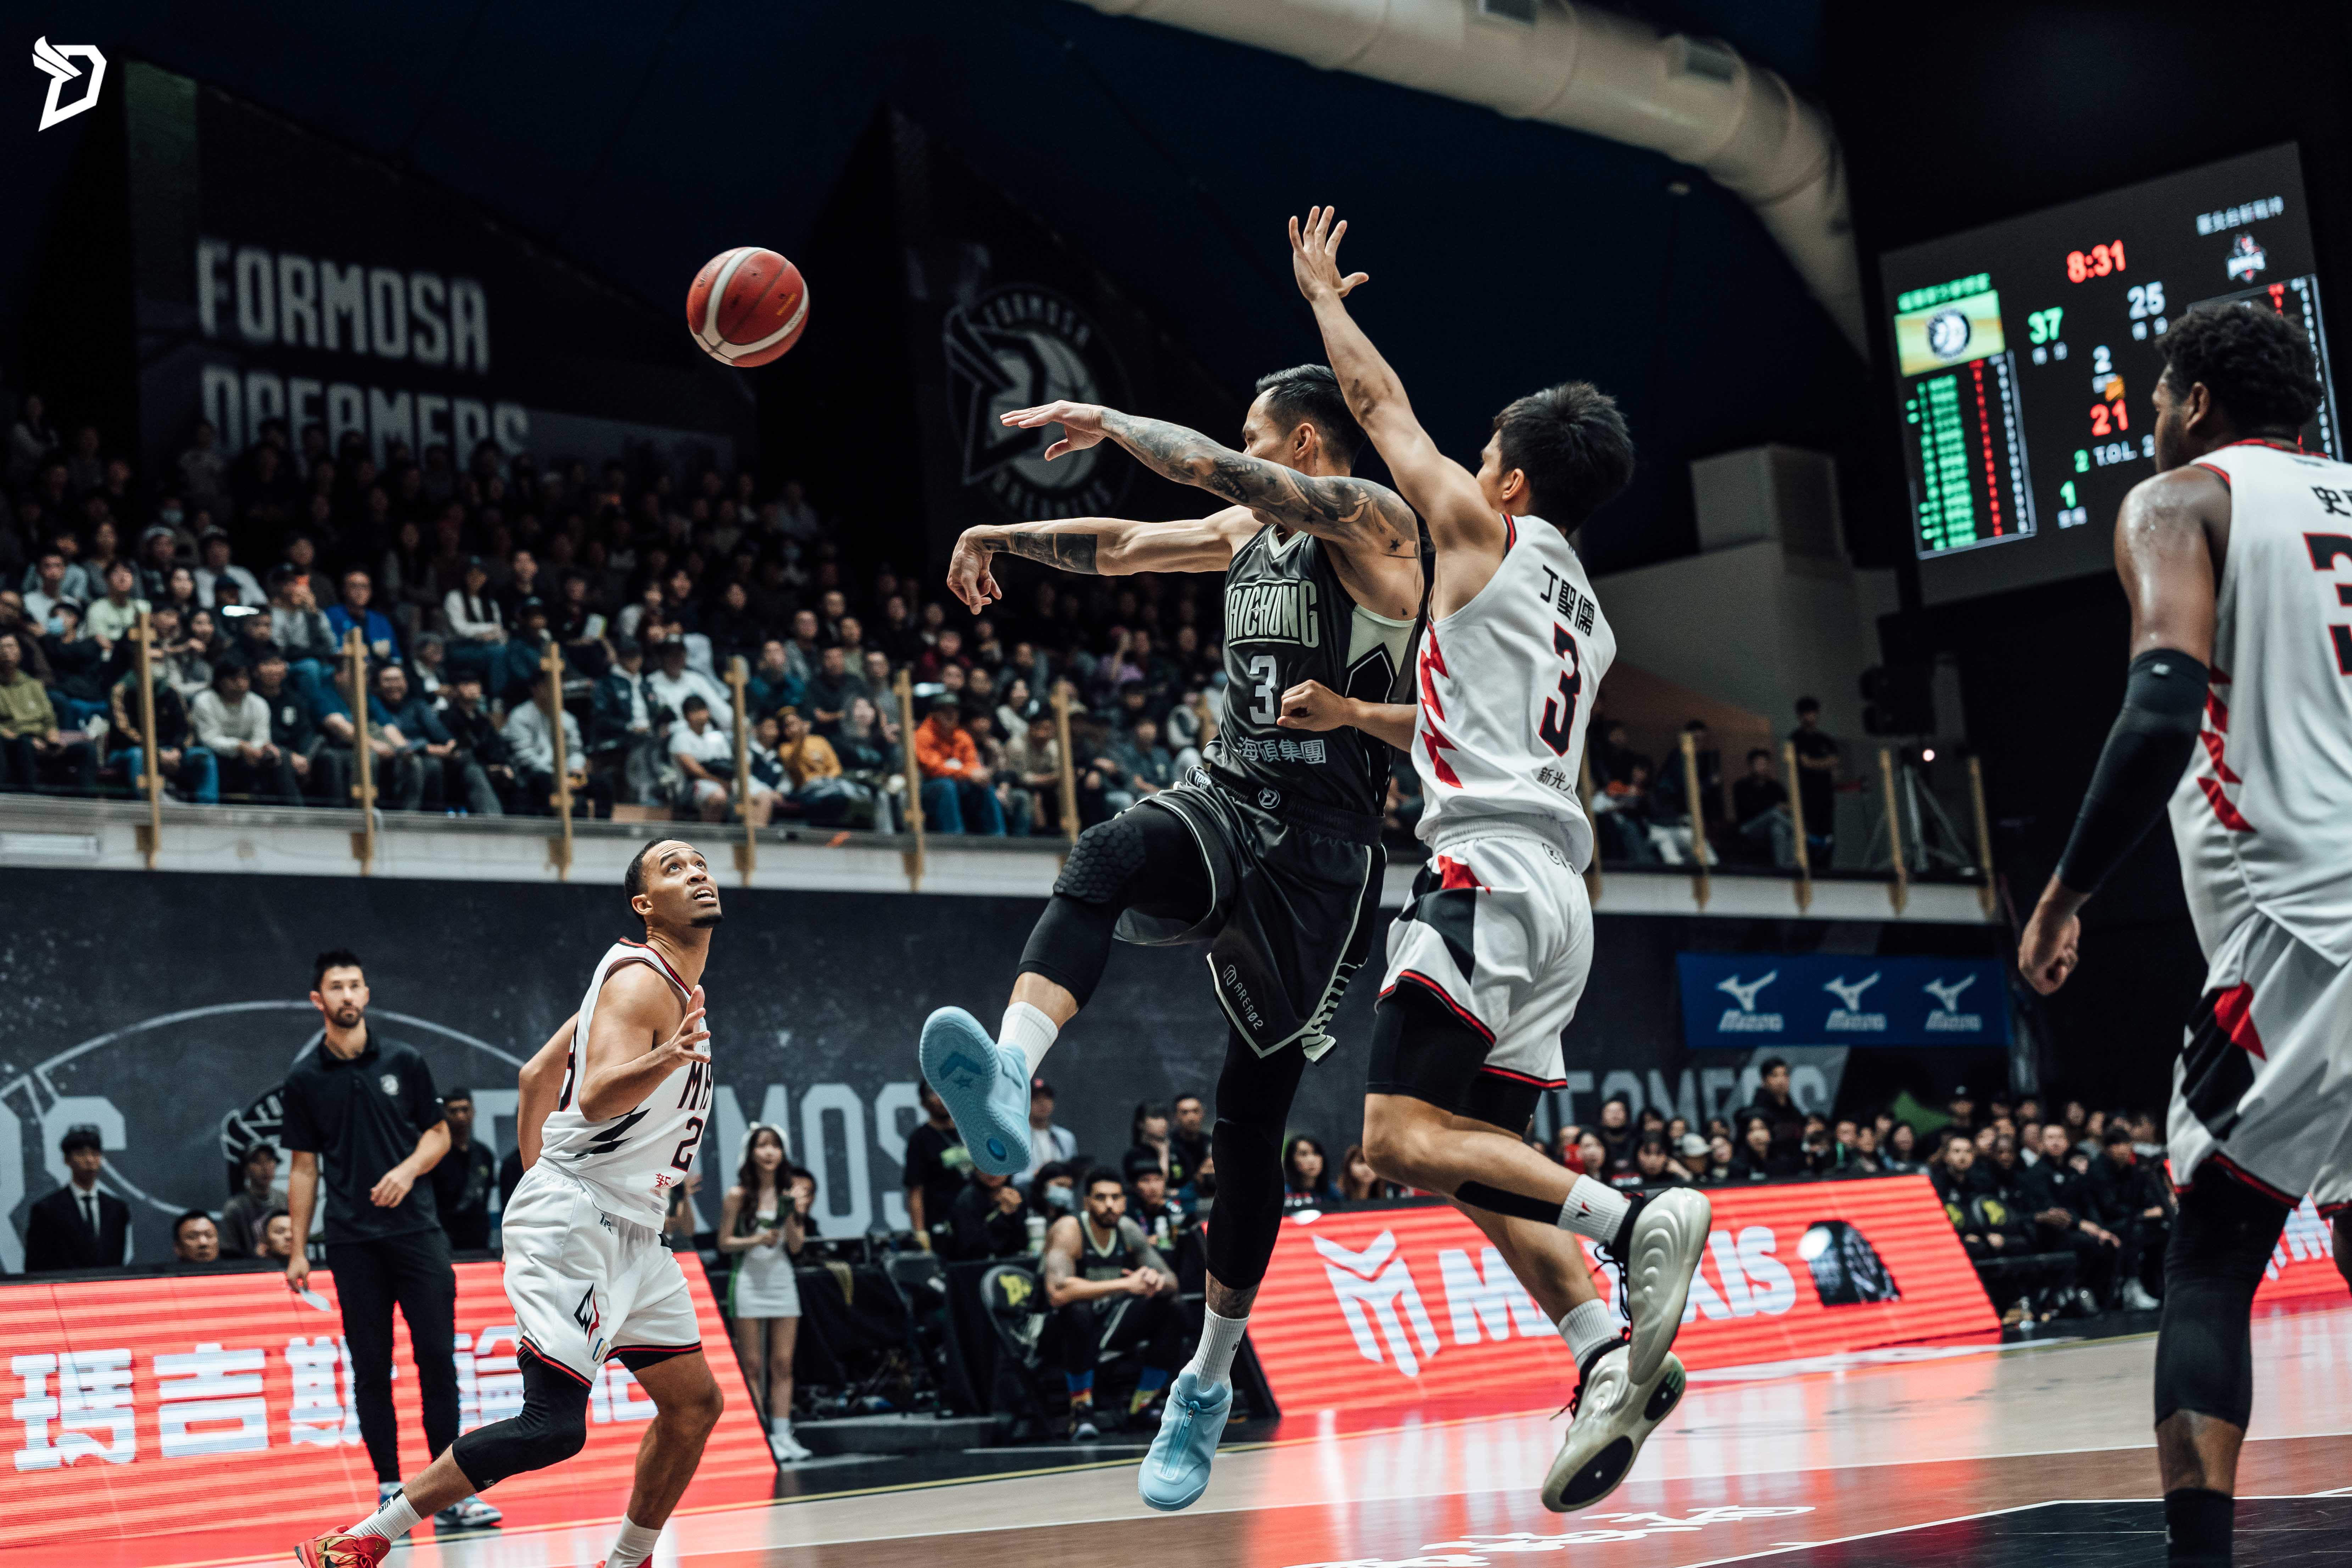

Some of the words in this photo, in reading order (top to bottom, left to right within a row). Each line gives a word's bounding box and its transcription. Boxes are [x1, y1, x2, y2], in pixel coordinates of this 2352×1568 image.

[2067, 239, 2125, 283] 8:31
[197, 236, 491, 374] FORMOSA
[2127, 281, 2166, 320] 25
[2028, 307, 2063, 345] 37
[2090, 399, 2128, 436] 21
[2311, 486, 2352, 516] 史
[1540, 564, 1594, 637] 丁聖儒
[1249, 655, 1277, 725] 3
[1539, 621, 1581, 757] 3
[1237, 736, 1326, 764] 海碩集團
[670, 1116, 704, 1172] 2
[655, 1173, 678, 1189] 新
[1438, 1226, 1797, 1345] MIS
[12, 1325, 659, 1472] 瑪吉斯
[378, 1498, 390, 1515] NIKE
